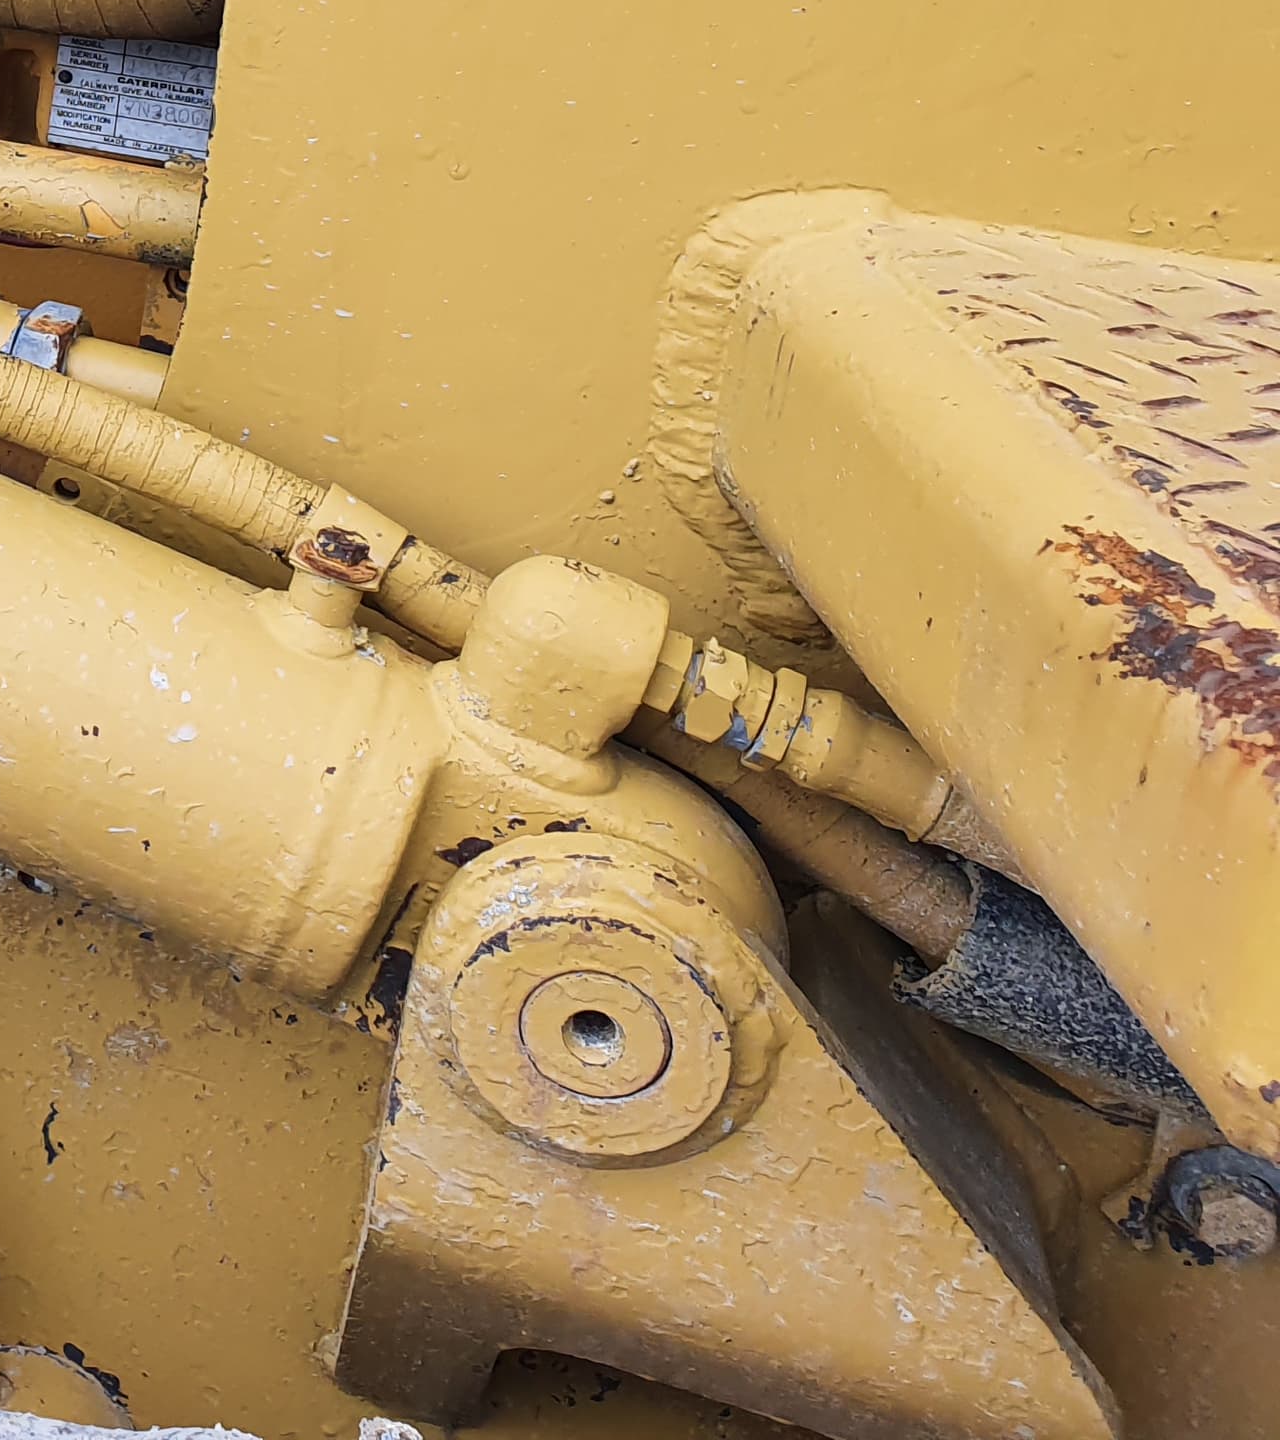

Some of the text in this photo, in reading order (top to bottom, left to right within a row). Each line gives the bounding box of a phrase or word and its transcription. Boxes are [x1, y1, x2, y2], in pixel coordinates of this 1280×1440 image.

[69, 58, 109, 71] NUMBER
[117, 76, 204, 96] CATERPILLAR
[121, 86, 142, 96] GIVE
[144, 89, 162, 99] ALL
[60, 88, 114, 103] ARRANGEMENT
[67, 98, 106, 110] NUMBER
[57, 110, 111, 124] MODIFICATION
[63, 120, 102, 132] NUMBER
[103, 137, 125, 147] MADE
[147, 145, 175, 154] JAPAN
